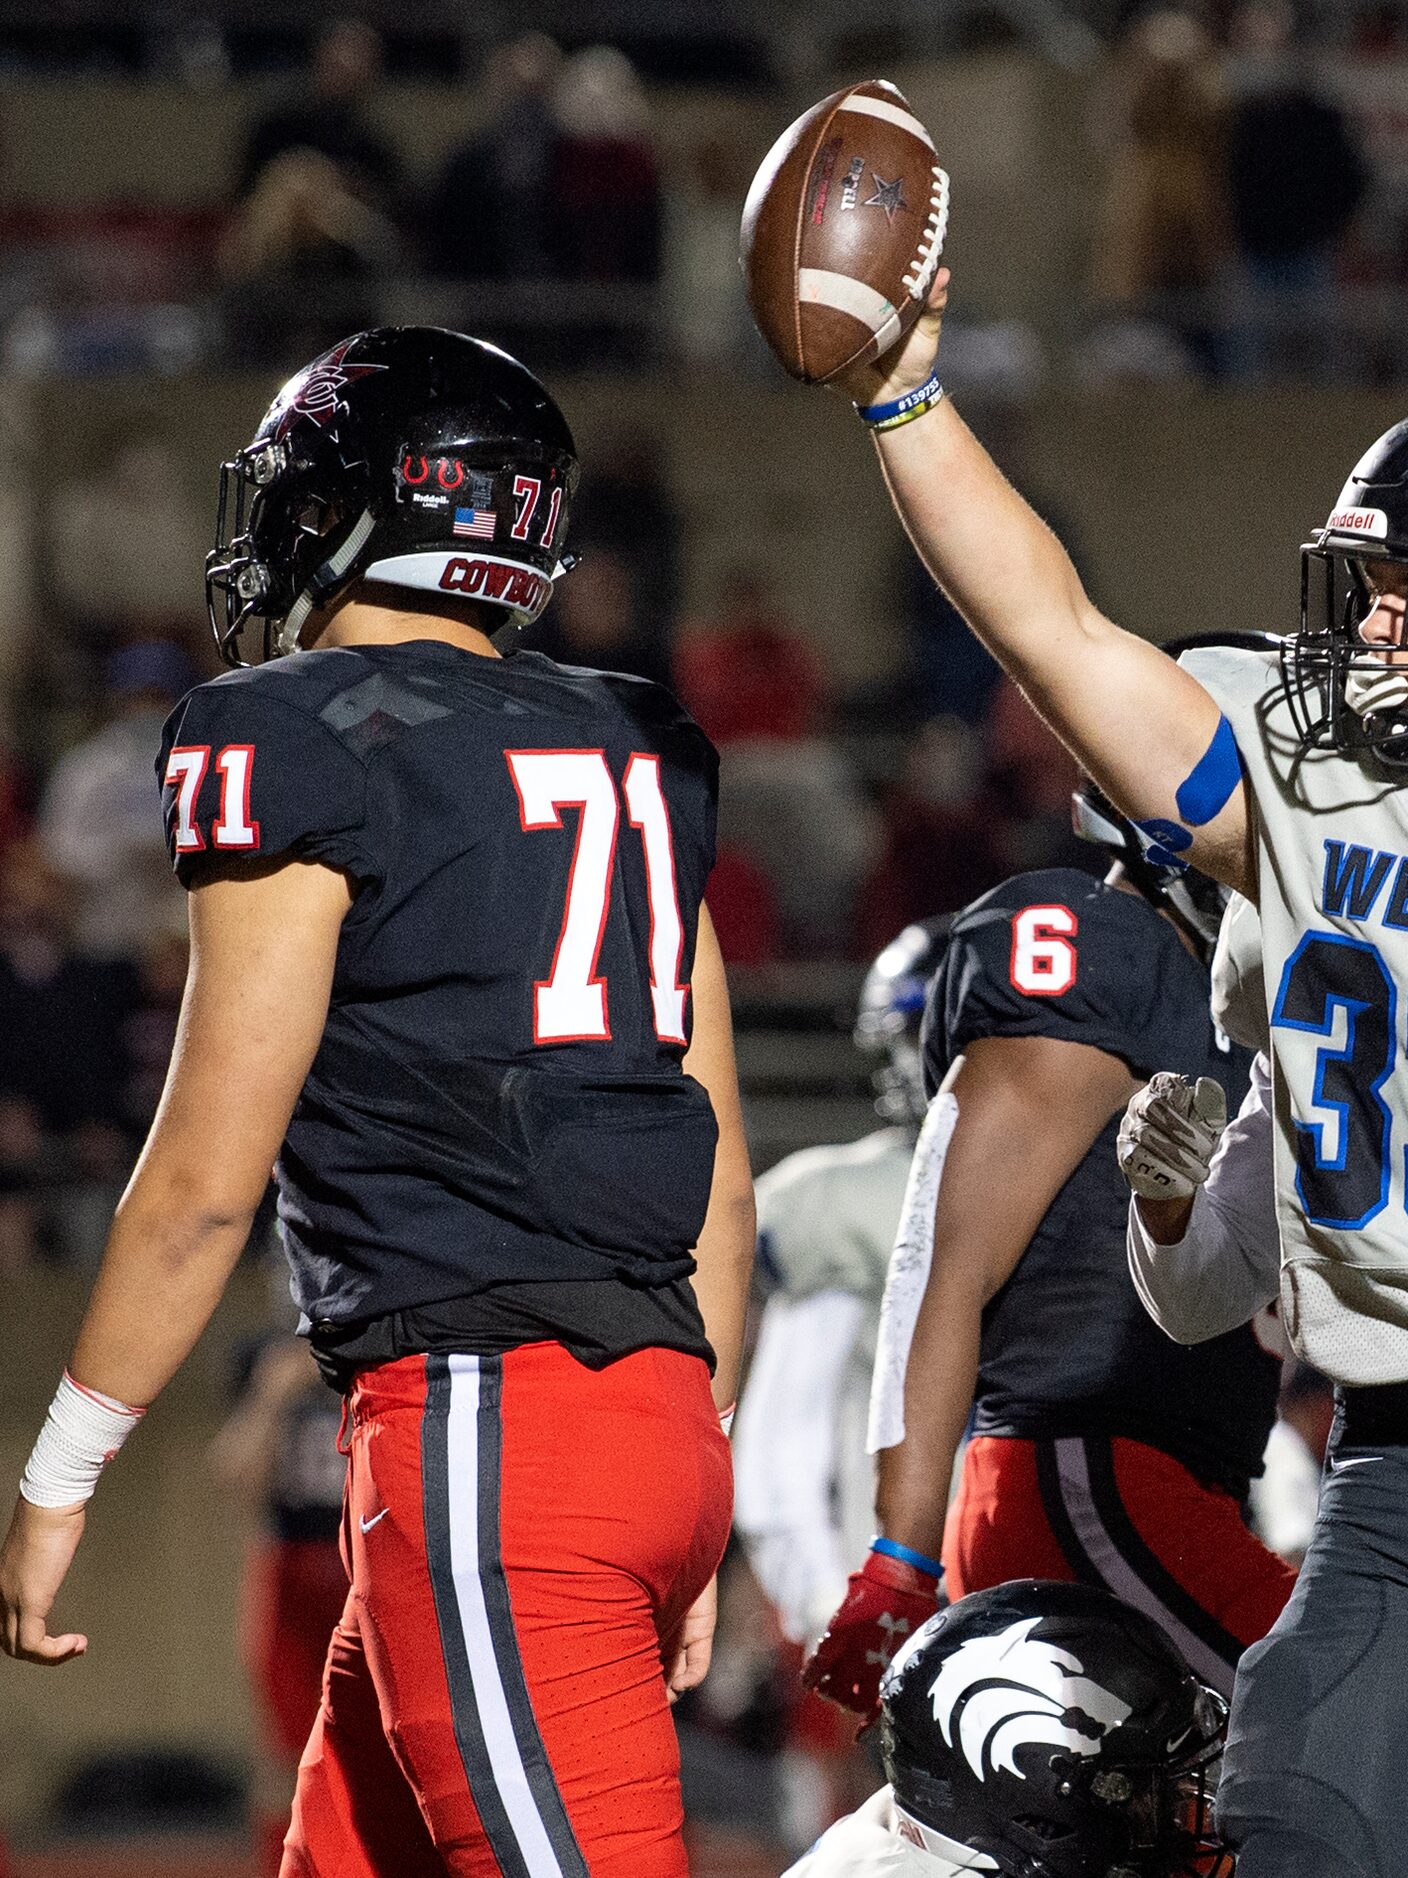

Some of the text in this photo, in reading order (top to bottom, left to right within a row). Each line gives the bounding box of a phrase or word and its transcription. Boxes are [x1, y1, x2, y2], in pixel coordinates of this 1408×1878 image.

[510, 474, 562, 548] 71
[165, 745, 261, 853] 71
[504, 748, 691, 1048] 71
[1010, 903, 1078, 997] 6
